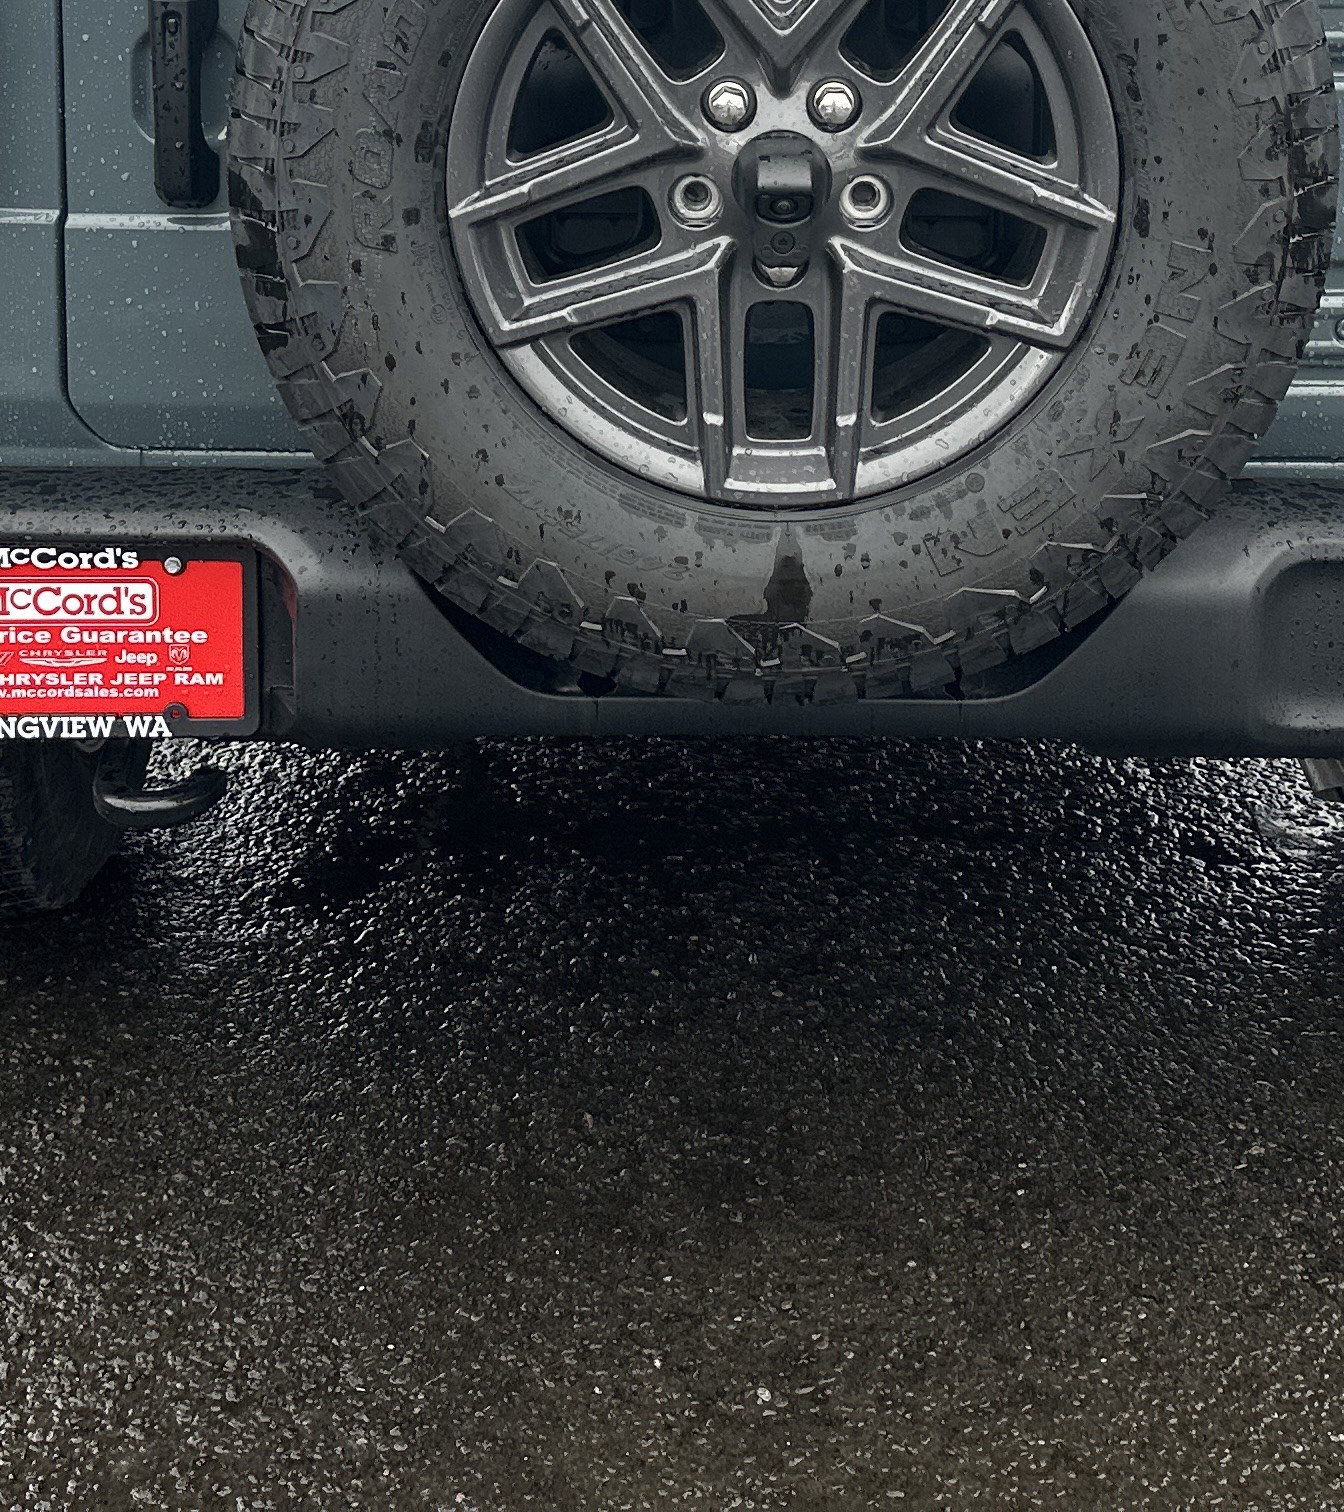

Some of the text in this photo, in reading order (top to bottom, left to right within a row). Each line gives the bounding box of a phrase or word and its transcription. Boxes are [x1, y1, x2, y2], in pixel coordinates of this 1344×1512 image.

[922, 240, 1212, 578] NEXEN
[60, 626, 208, 644] Guarantee
[115, 649, 158, 666] Jeep
[109, 673, 167, 686] JEEP
[174, 673, 224, 685] RAM
[122, 716, 173, 738] WA
